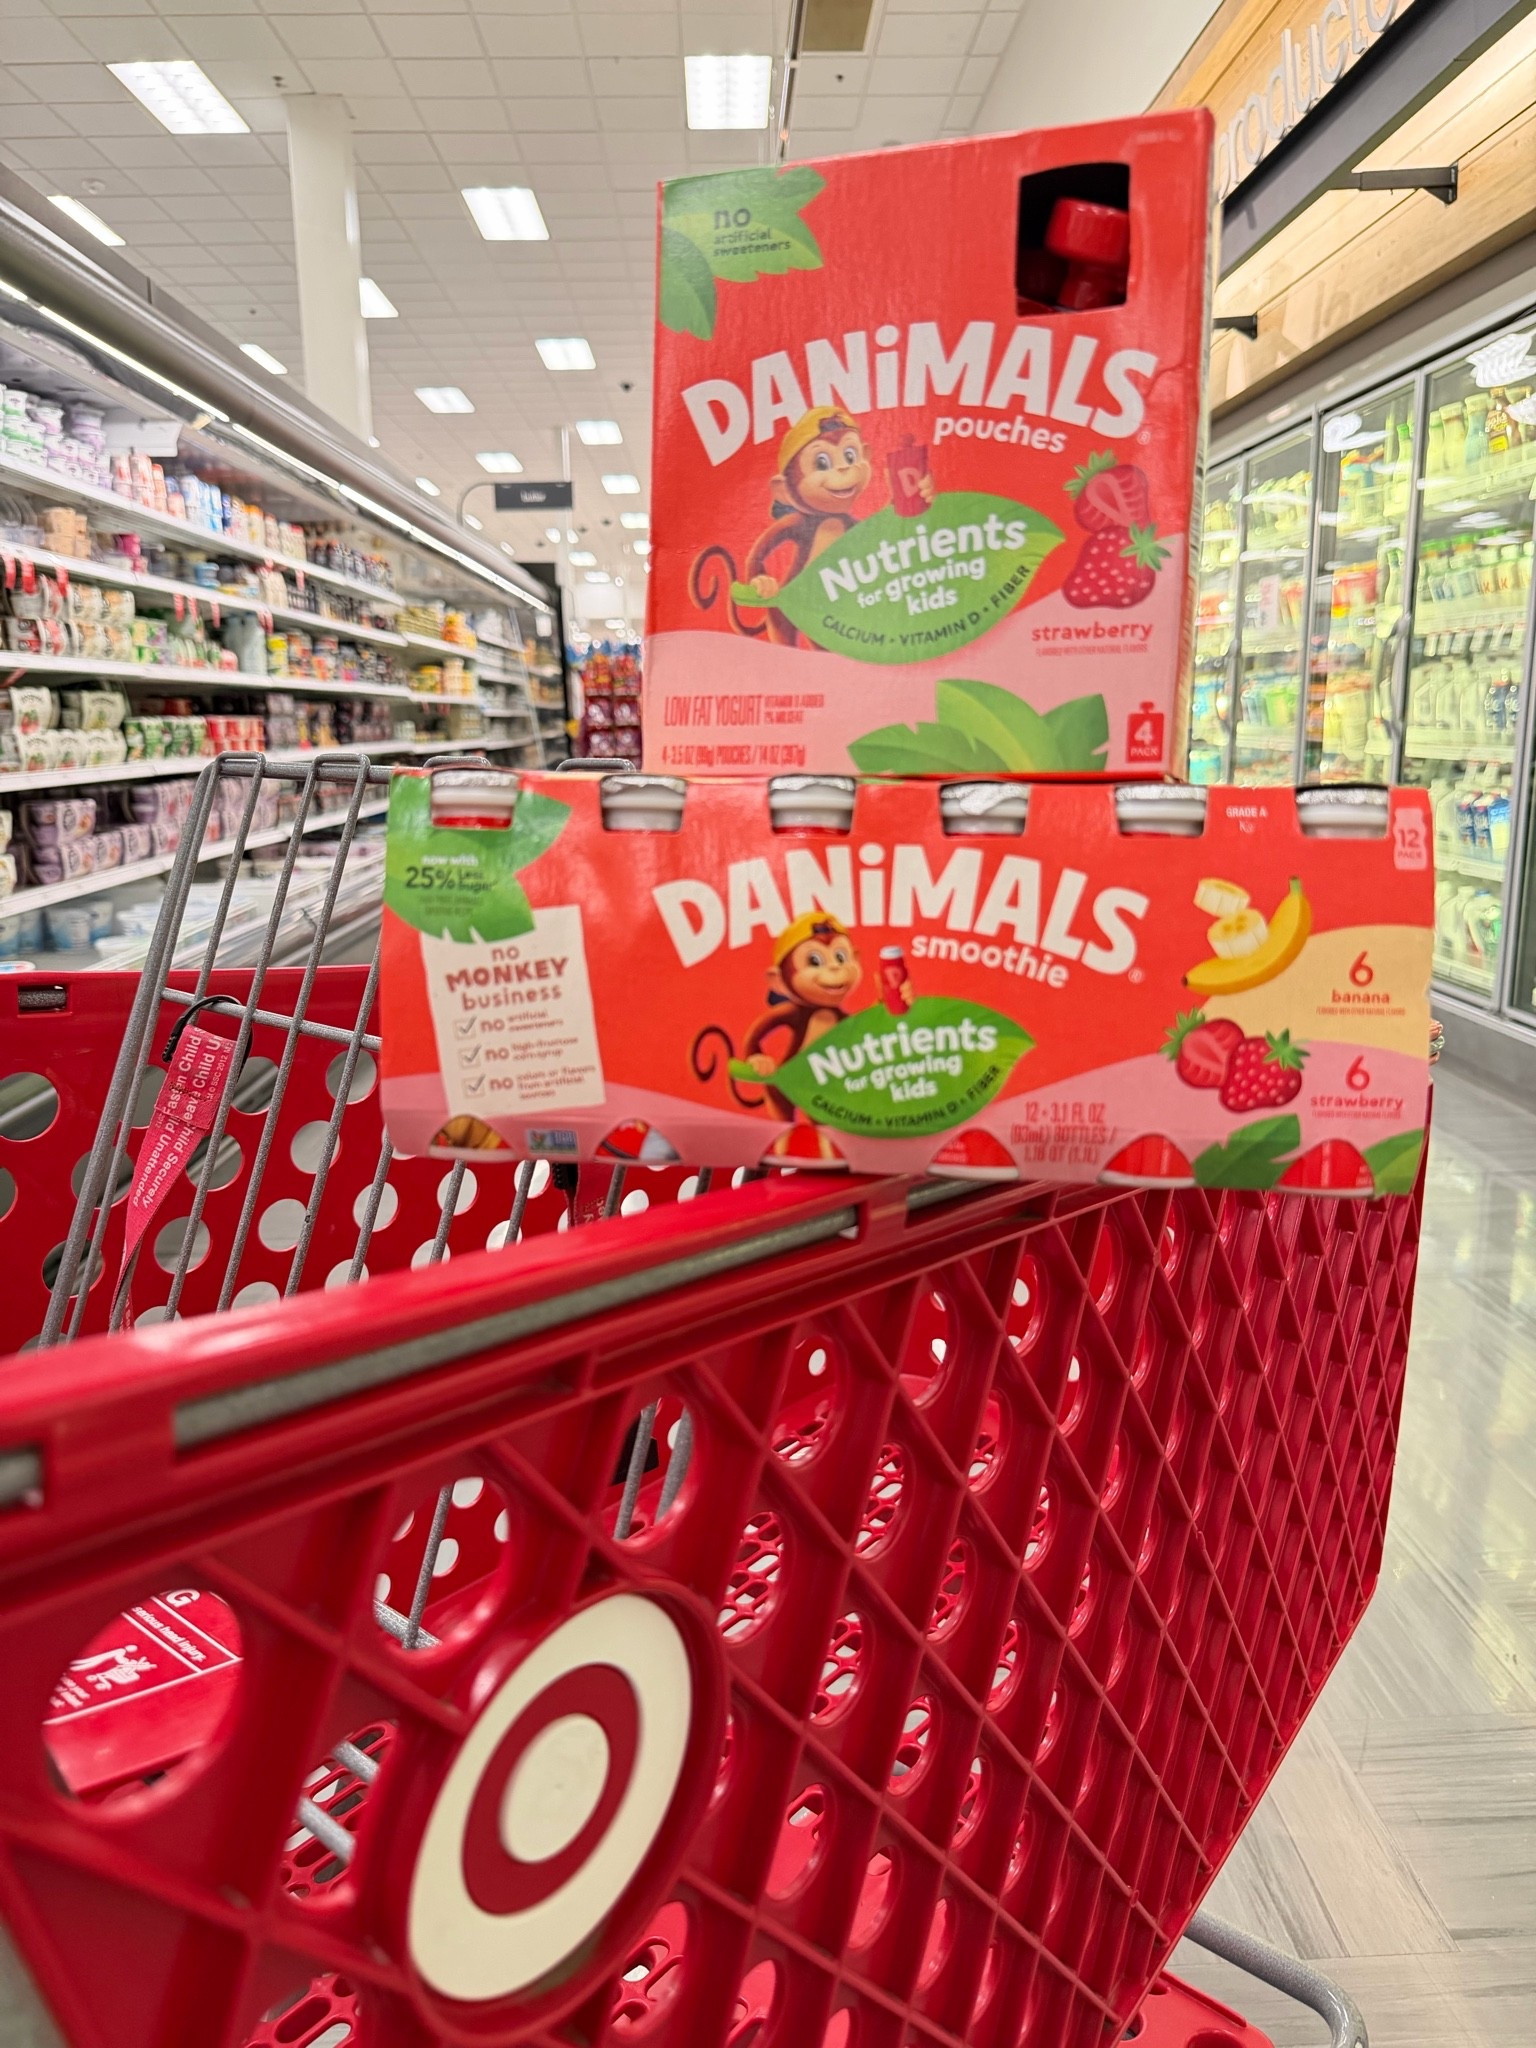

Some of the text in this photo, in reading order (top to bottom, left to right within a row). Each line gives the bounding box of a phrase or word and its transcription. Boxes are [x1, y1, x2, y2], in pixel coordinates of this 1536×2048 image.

[714, 208, 751, 229] no
[713, 228, 771, 245] artificial
[713, 241, 791, 256] sweeteners
[933, 415, 1067, 454] pouches
[818, 513, 1028, 602] Nutrients
[857, 556, 987, 609] for growing
[821, 564, 1031, 647] CALCIUM VITAMIN D FIBER
[906, 585, 958, 616] kids
[1032, 621, 1154, 642] strawberry
[664, 694, 762, 727] LOW FAT YOGURT
[1134, 720, 1153, 746] 4
[1130, 746, 1160, 758] PACK
[1226, 806, 1268, 818] GRADE A
[1397, 829, 1420, 849] 12
[1397, 851, 1422, 860] PACK
[405, 866, 456, 889] 25%
[492, 946, 520, 961] no
[911, 932, 1070, 989] smoothie
[445, 957, 568, 992] MONKEY
[1349, 950, 1374, 987] 6
[461, 985, 562, 1012] business
[1331, 989, 1390, 1004] banana
[480, 1019, 505, 1033] no
[179, 1036, 202, 1073] Child
[485, 1047, 510, 1062] no
[807, 1017, 998, 1086] Nutrients
[193, 1052, 216, 1089] Child
[489, 1077, 514, 1091] no
[843, 1054, 963, 1093] for growing
[1346, 1055, 1371, 1091] 6
[811, 1064, 1001, 1127] CALCIUM VITAMIN D FIBER
[889, 1076, 938, 1103] kids
[1311, 1095, 1404, 1110] strawberry
[1026, 1102, 1039, 1122] 12
[1089, 1102, 1105, 1123] OZ
[1054, 1125, 1106, 1145] BOTTLES
[132, 1131, 172, 1208] Unattended
[141, 1123, 198, 1210] hild Securely
[133, 1606, 163, 1630] serious
[162, 1625, 184, 1645] head
